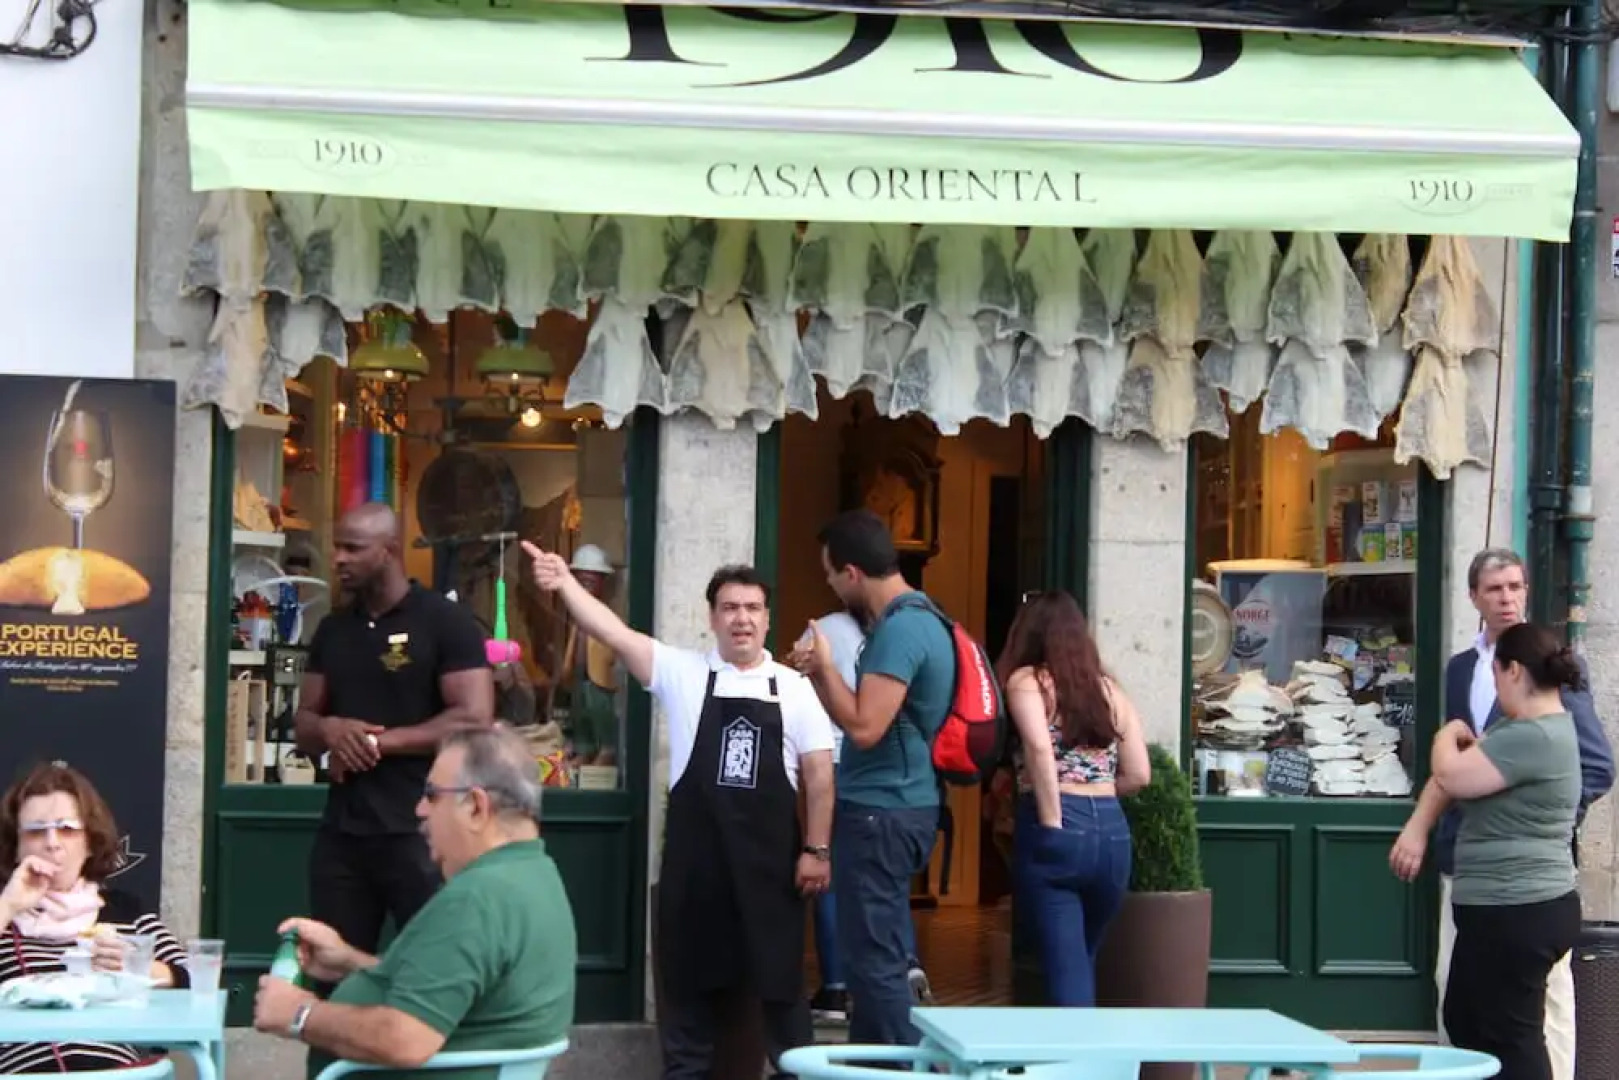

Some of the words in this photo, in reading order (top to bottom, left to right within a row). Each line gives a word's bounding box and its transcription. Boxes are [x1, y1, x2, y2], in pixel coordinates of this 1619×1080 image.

[314, 138, 383, 165] 1910
[706, 161, 831, 199] CASA
[846, 166, 1098, 203] ORIENTAL
[1410, 179, 1473, 206] 1910
[2, 624, 128, 642] PORTUGAL
